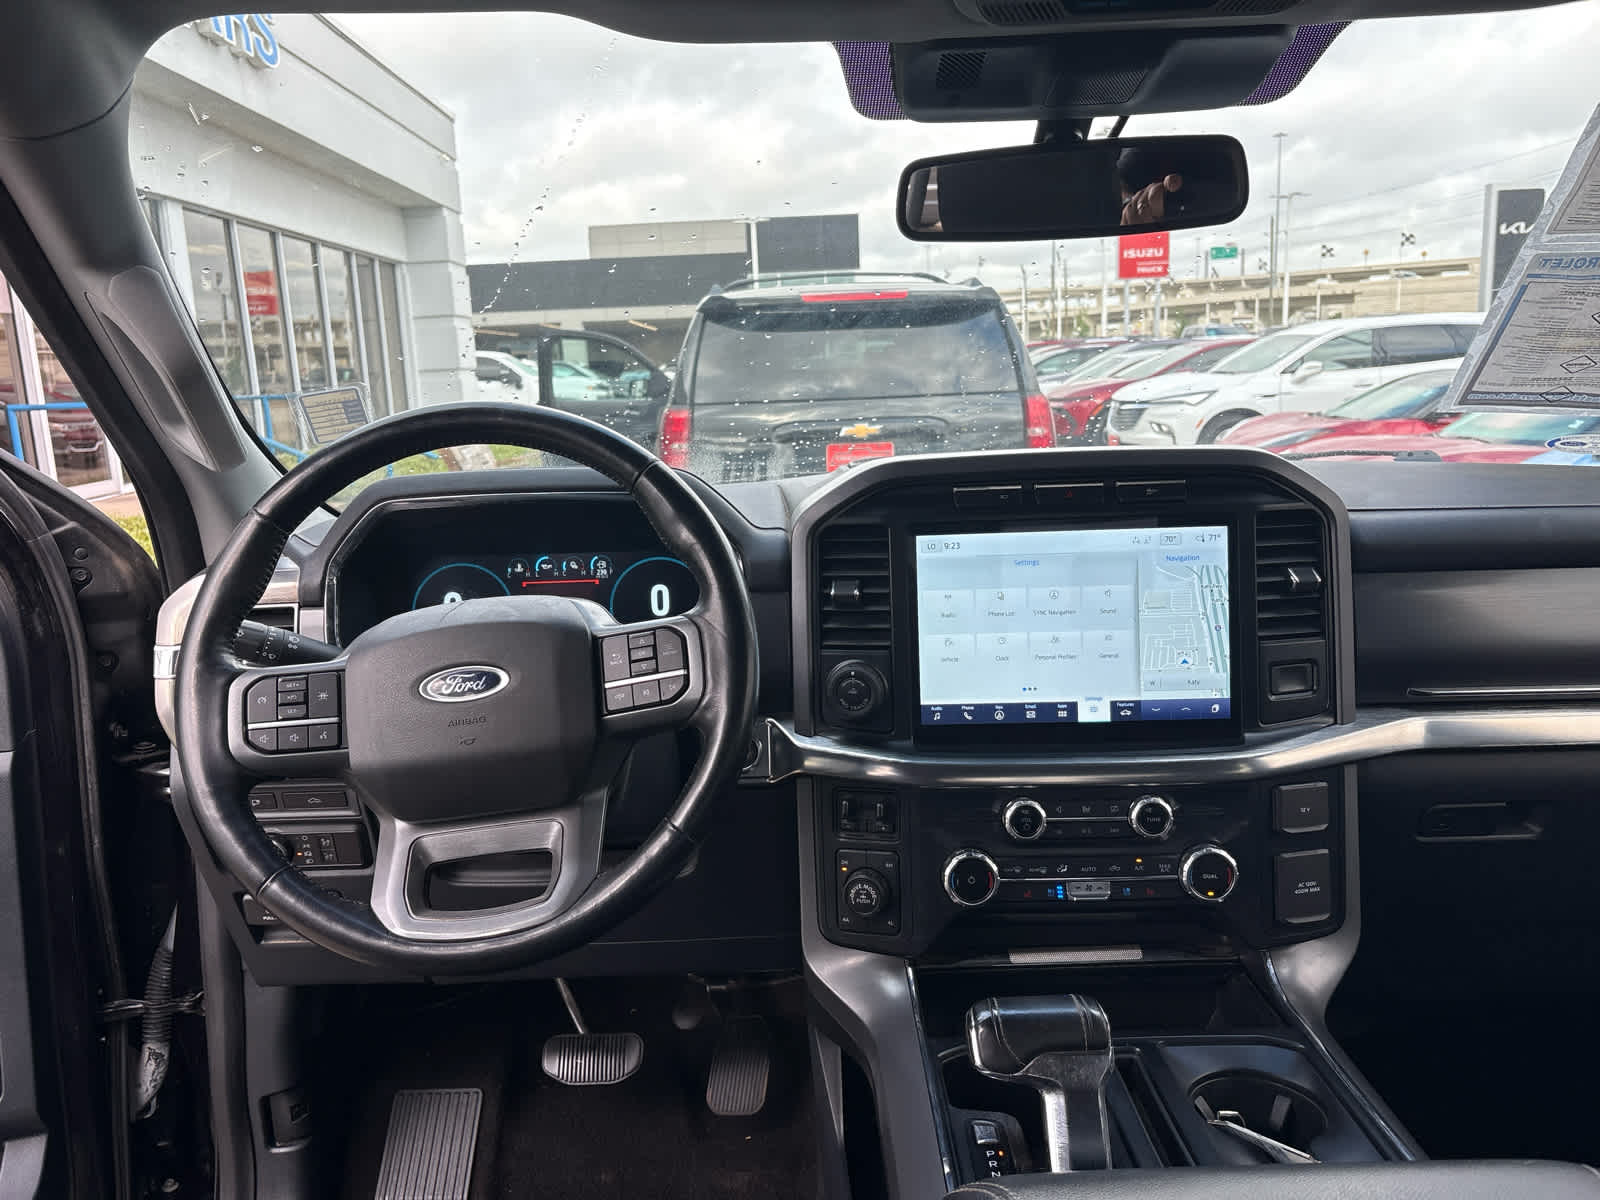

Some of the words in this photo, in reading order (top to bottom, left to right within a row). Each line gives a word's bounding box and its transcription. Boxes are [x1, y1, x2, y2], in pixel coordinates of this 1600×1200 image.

[1122, 247, 1164, 258] ISUZU
[944, 542, 960, 550] 9:23
[650, 583, 670, 617] 0
[442, 673, 486, 694] Ford
[447, 716, 486, 727] AIRBAG
[988, 1160, 998, 1168] R
